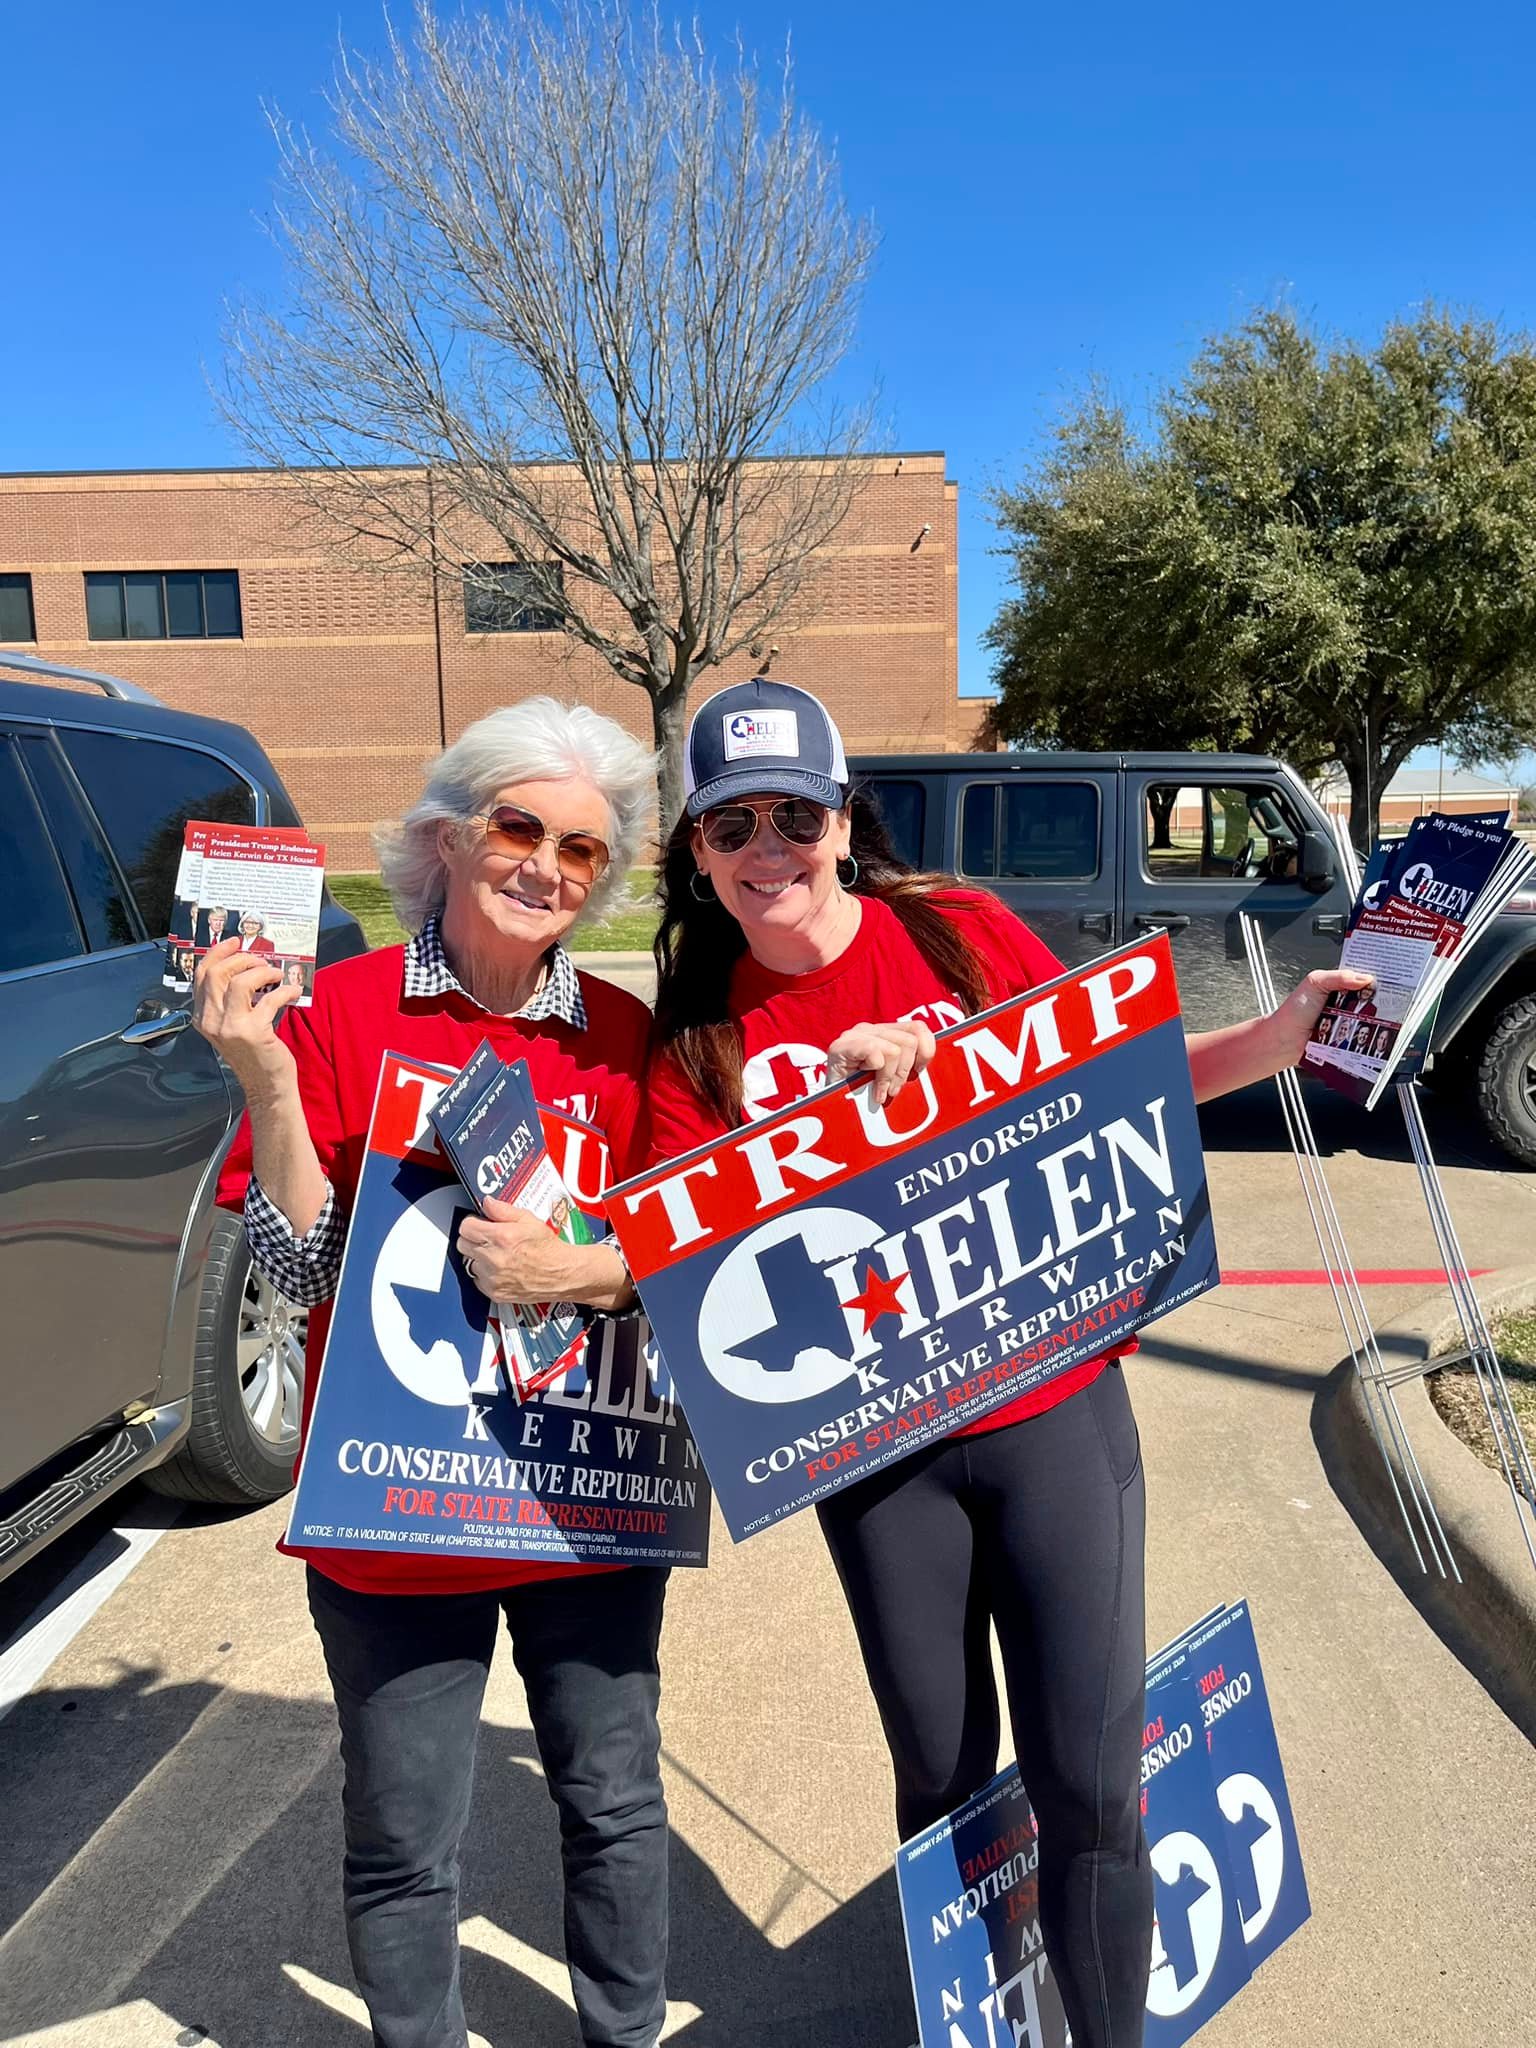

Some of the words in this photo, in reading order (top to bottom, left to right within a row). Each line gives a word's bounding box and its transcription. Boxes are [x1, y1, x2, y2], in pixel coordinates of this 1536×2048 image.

[210, 839, 250, 848] President
[251, 841, 279, 852] Trump
[210, 849, 232, 858] Helen
[234, 851, 261, 860] Kerwin
[263, 852, 274, 861] for
[1432, 818, 1447, 829] My
[1448, 822, 1473, 838] Pledge
[1475, 828, 1485, 838] to
[1486, 833, 1502, 843] you
[1390, 916, 1410, 926] Trump
[1413, 877, 1475, 913] HELEN
[623, 955, 1157, 1252] TRUMP
[490, 1119, 533, 1178] HELEN
[894, 1092, 1082, 1206] ENDORSED
[823, 1096, 1175, 1367] HELEN
[848, 1198, 1183, 1396] KERWIN
[745, 1341, 993, 1484] CONSERVATIVE
[996, 1233, 1186, 1357] REPUBLICAN
[805, 1441, 860, 1480] FOR
[864, 1398, 942, 1450] STATE
[945, 1286, 1146, 1409] REPRESENTATIVE
[774, 1508, 781, 1516] IT
[782, 1504, 790, 1512] IS
[796, 1482, 832, 1505] VIOLATION
[832, 1476, 842, 1486] OF
[844, 1464, 865, 1480] STATE
[865, 1457, 880, 1470] LAW
[882, 1437, 920, 1463] (CHAPTERS
[932, 1423, 947, 1435] AND
[960, 1384, 1018, 1419] TRANSPORTATION
[1041, 1367, 1052, 1376] TO
[1051, 1355, 1072, 1372] PLACE
[1072, 1347, 1088, 1359] THIS
[1088, 1338, 1104, 1351] SIGN
[1104, 1334, 1111, 1342] IN
[1111, 1326, 1124, 1338] THE
[1166, 1296, 1175, 1306] OF
[894, 1424, 929, 1446] POLITICAL
[929, 1418, 939, 1428] AD
[939, 1410, 955, 1422] PAID
[955, 1402, 970, 1414] FOR
[970, 1396, 979, 1406] BY
[980, 1388, 994, 1400] THE
[994, 1377, 1016, 1394] HELEN
[1016, 1363, 1042, 1382] KERWIN
[1042, 1344, 1076, 1368] CAMPAIGN
[461, 1402, 700, 1470] KERWIN
[338, 1439, 566, 1495] CONSERVATIVE
[570, 1466, 697, 1508] REPUBLICAN
[303, 1524, 334, 1536] NOTICE:
[337, 1526, 344, 1537] IT
[345, 1527, 353, 1537] IS
[353, 1527, 360, 1537] A
[360, 1528, 397, 1541] VIOLATION
[397, 1532, 409, 1542] OF
[409, 1533, 430, 1544] STATE
[430, 1534, 446, 1545] LAW
[446, 1534, 483, 1547] (CHAPTERS
[494, 1539, 507, 1549] AND
[383, 1486, 437, 1517] FOR
[441, 1493, 512, 1524] STATE
[517, 1499, 668, 1535] REPRESENTATIVE
[463, 1523, 497, 1535] POLITICAL
[519, 1527, 531, 1537] FOR
[1200, 1664, 1226, 1695] FOR
